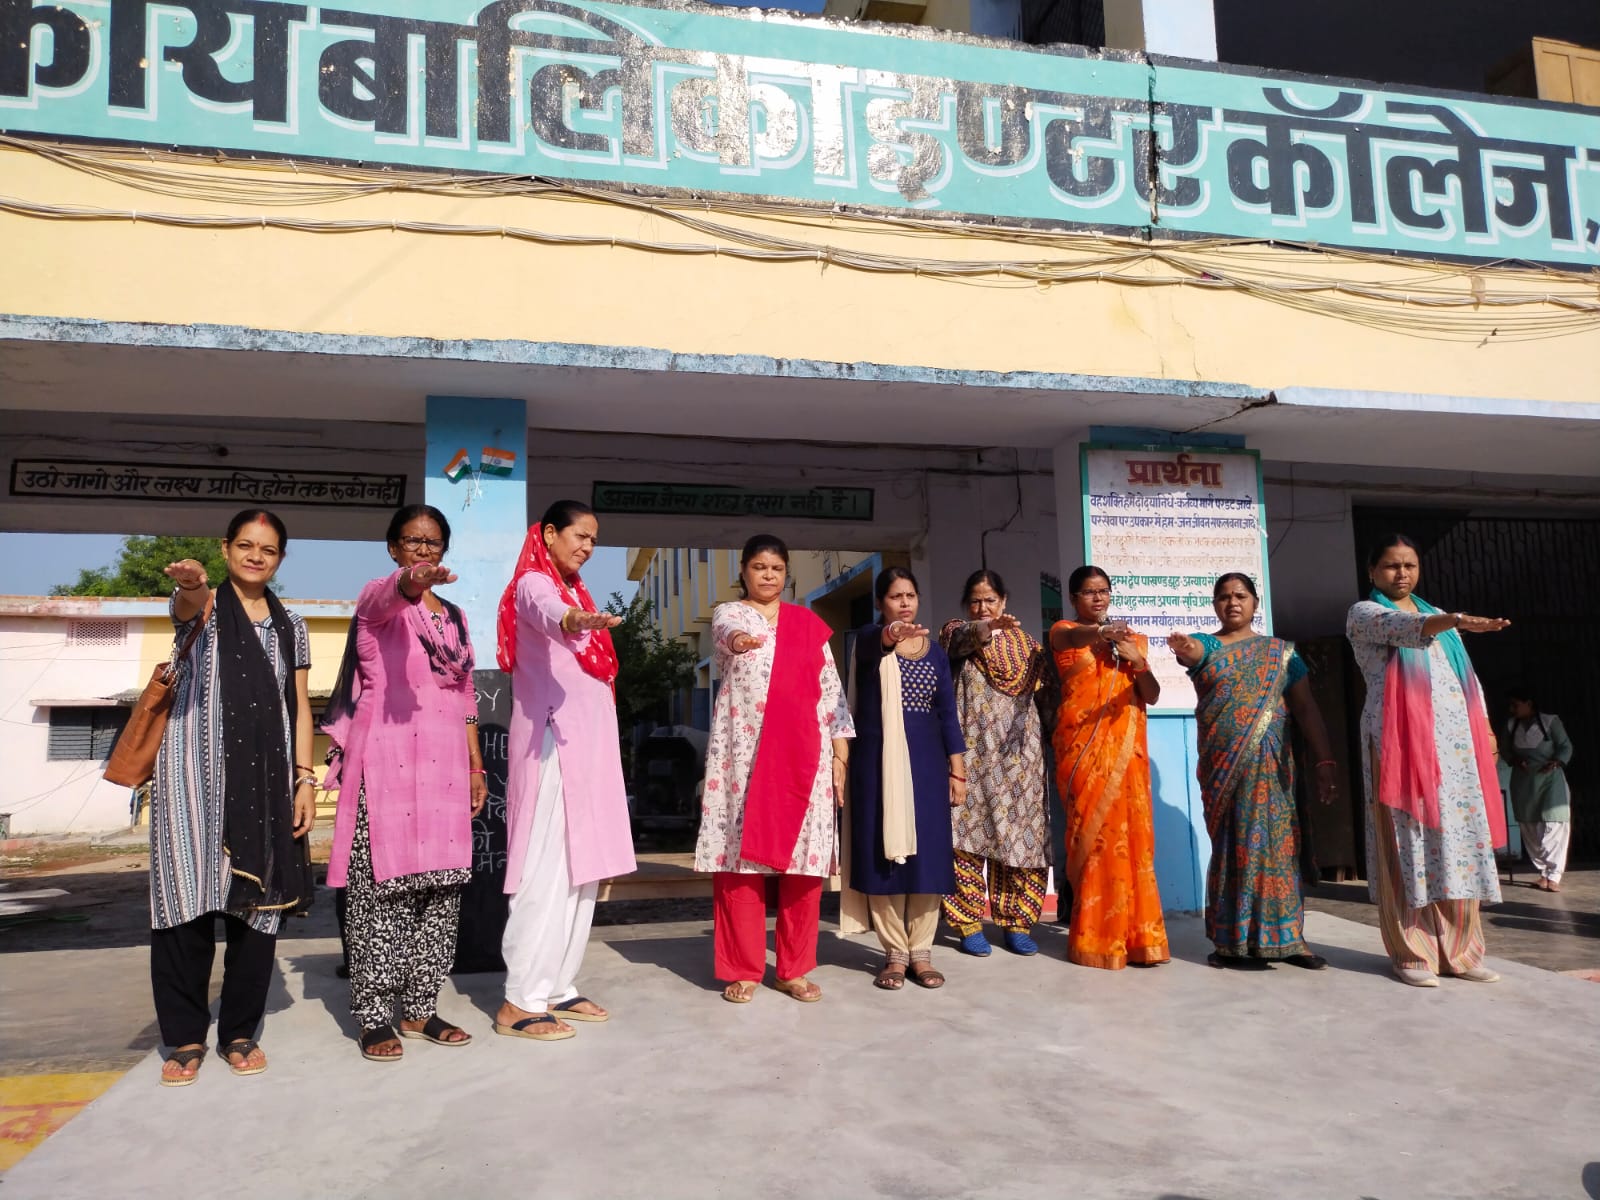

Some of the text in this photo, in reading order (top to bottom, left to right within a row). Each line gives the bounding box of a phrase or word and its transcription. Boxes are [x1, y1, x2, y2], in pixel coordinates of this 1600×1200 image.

[318, 0, 858, 177] बालिका
[865, 68, 1213, 207] इण्टर
[1222, 85, 1577, 242] कॉलेज
[21, 465, 65, 489] उठो
[60, 468, 111, 490] जागो
[111, 468, 153, 494] और
[207, 472, 264, 498] प्राप्ति
[262, 473, 298, 500] होने
[298, 481, 330, 499] तक
[1126, 453, 1222, 487] प्रार्थना
[1102, 491, 1124, 508] शक्ति
